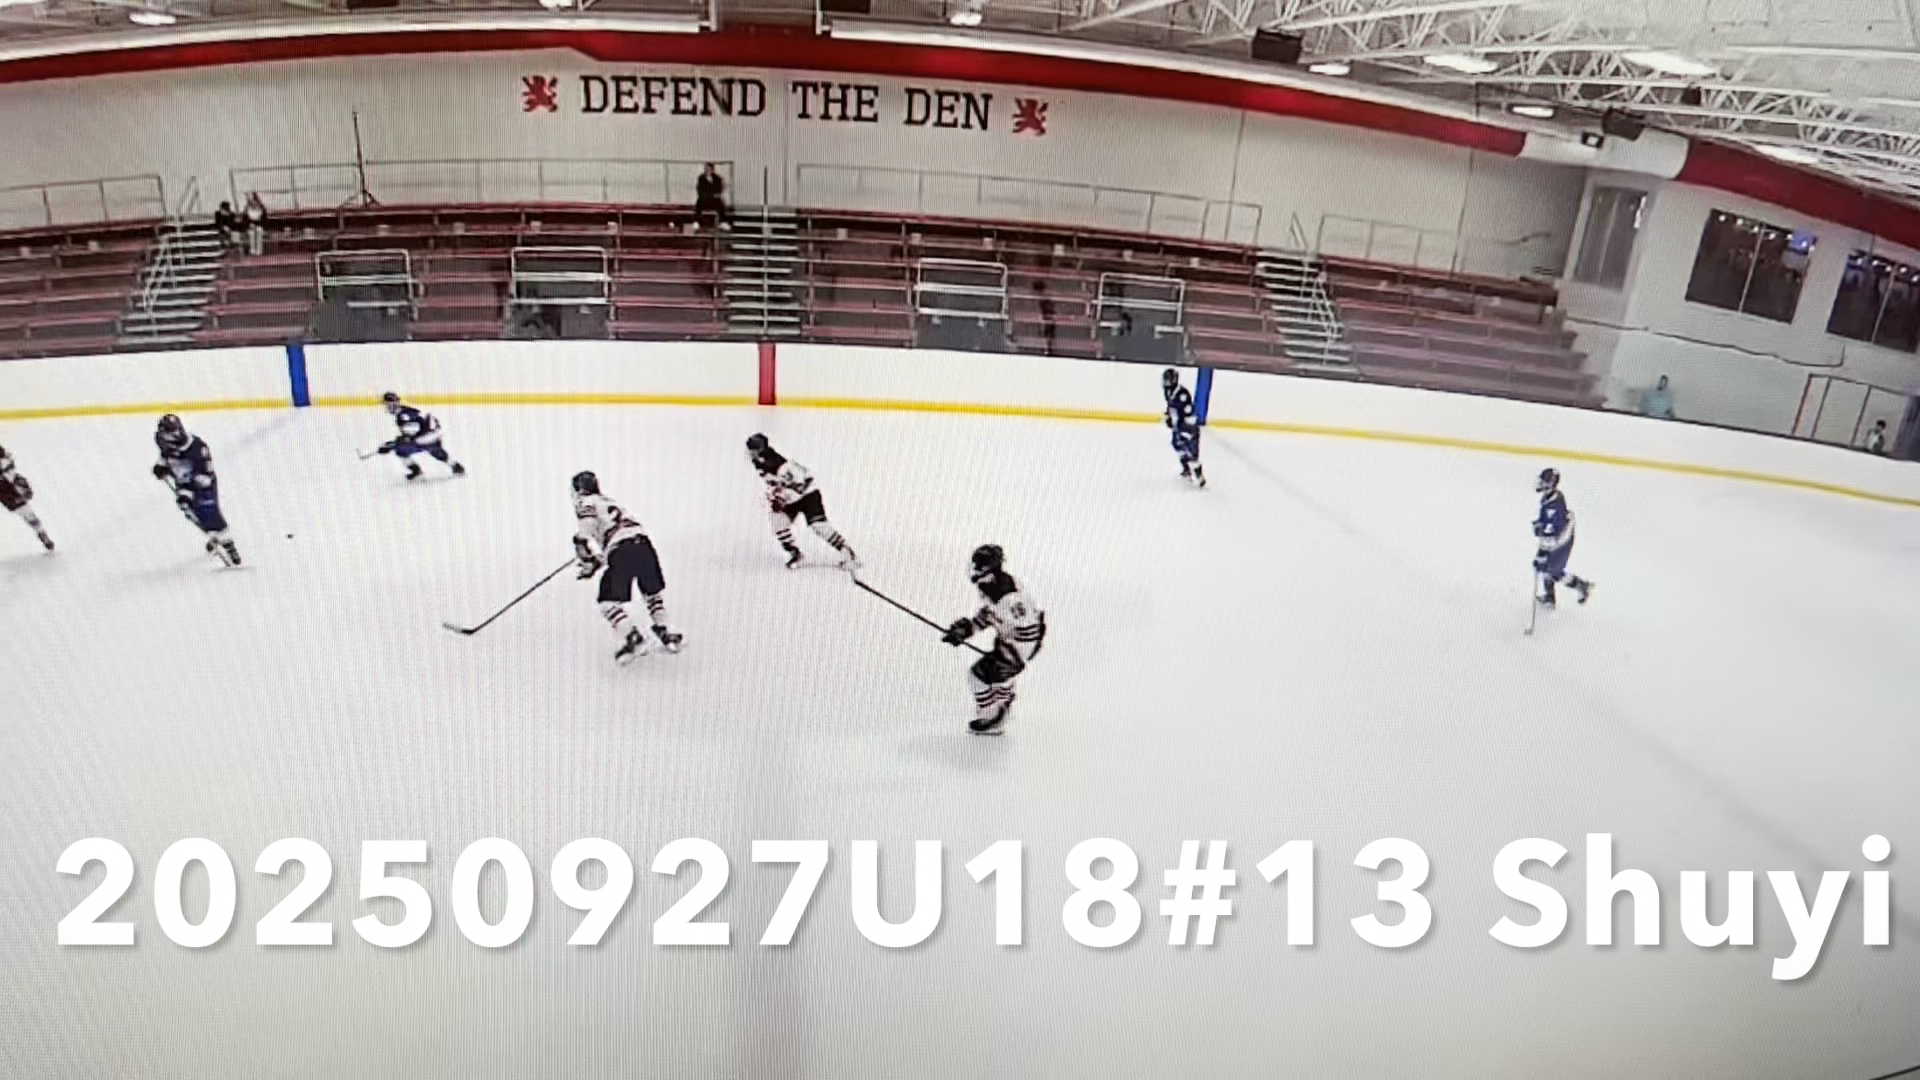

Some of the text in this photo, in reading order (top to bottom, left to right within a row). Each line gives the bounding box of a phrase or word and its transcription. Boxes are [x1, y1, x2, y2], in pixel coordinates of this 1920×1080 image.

[579, 74, 994, 131] DEFEND THE DEN
